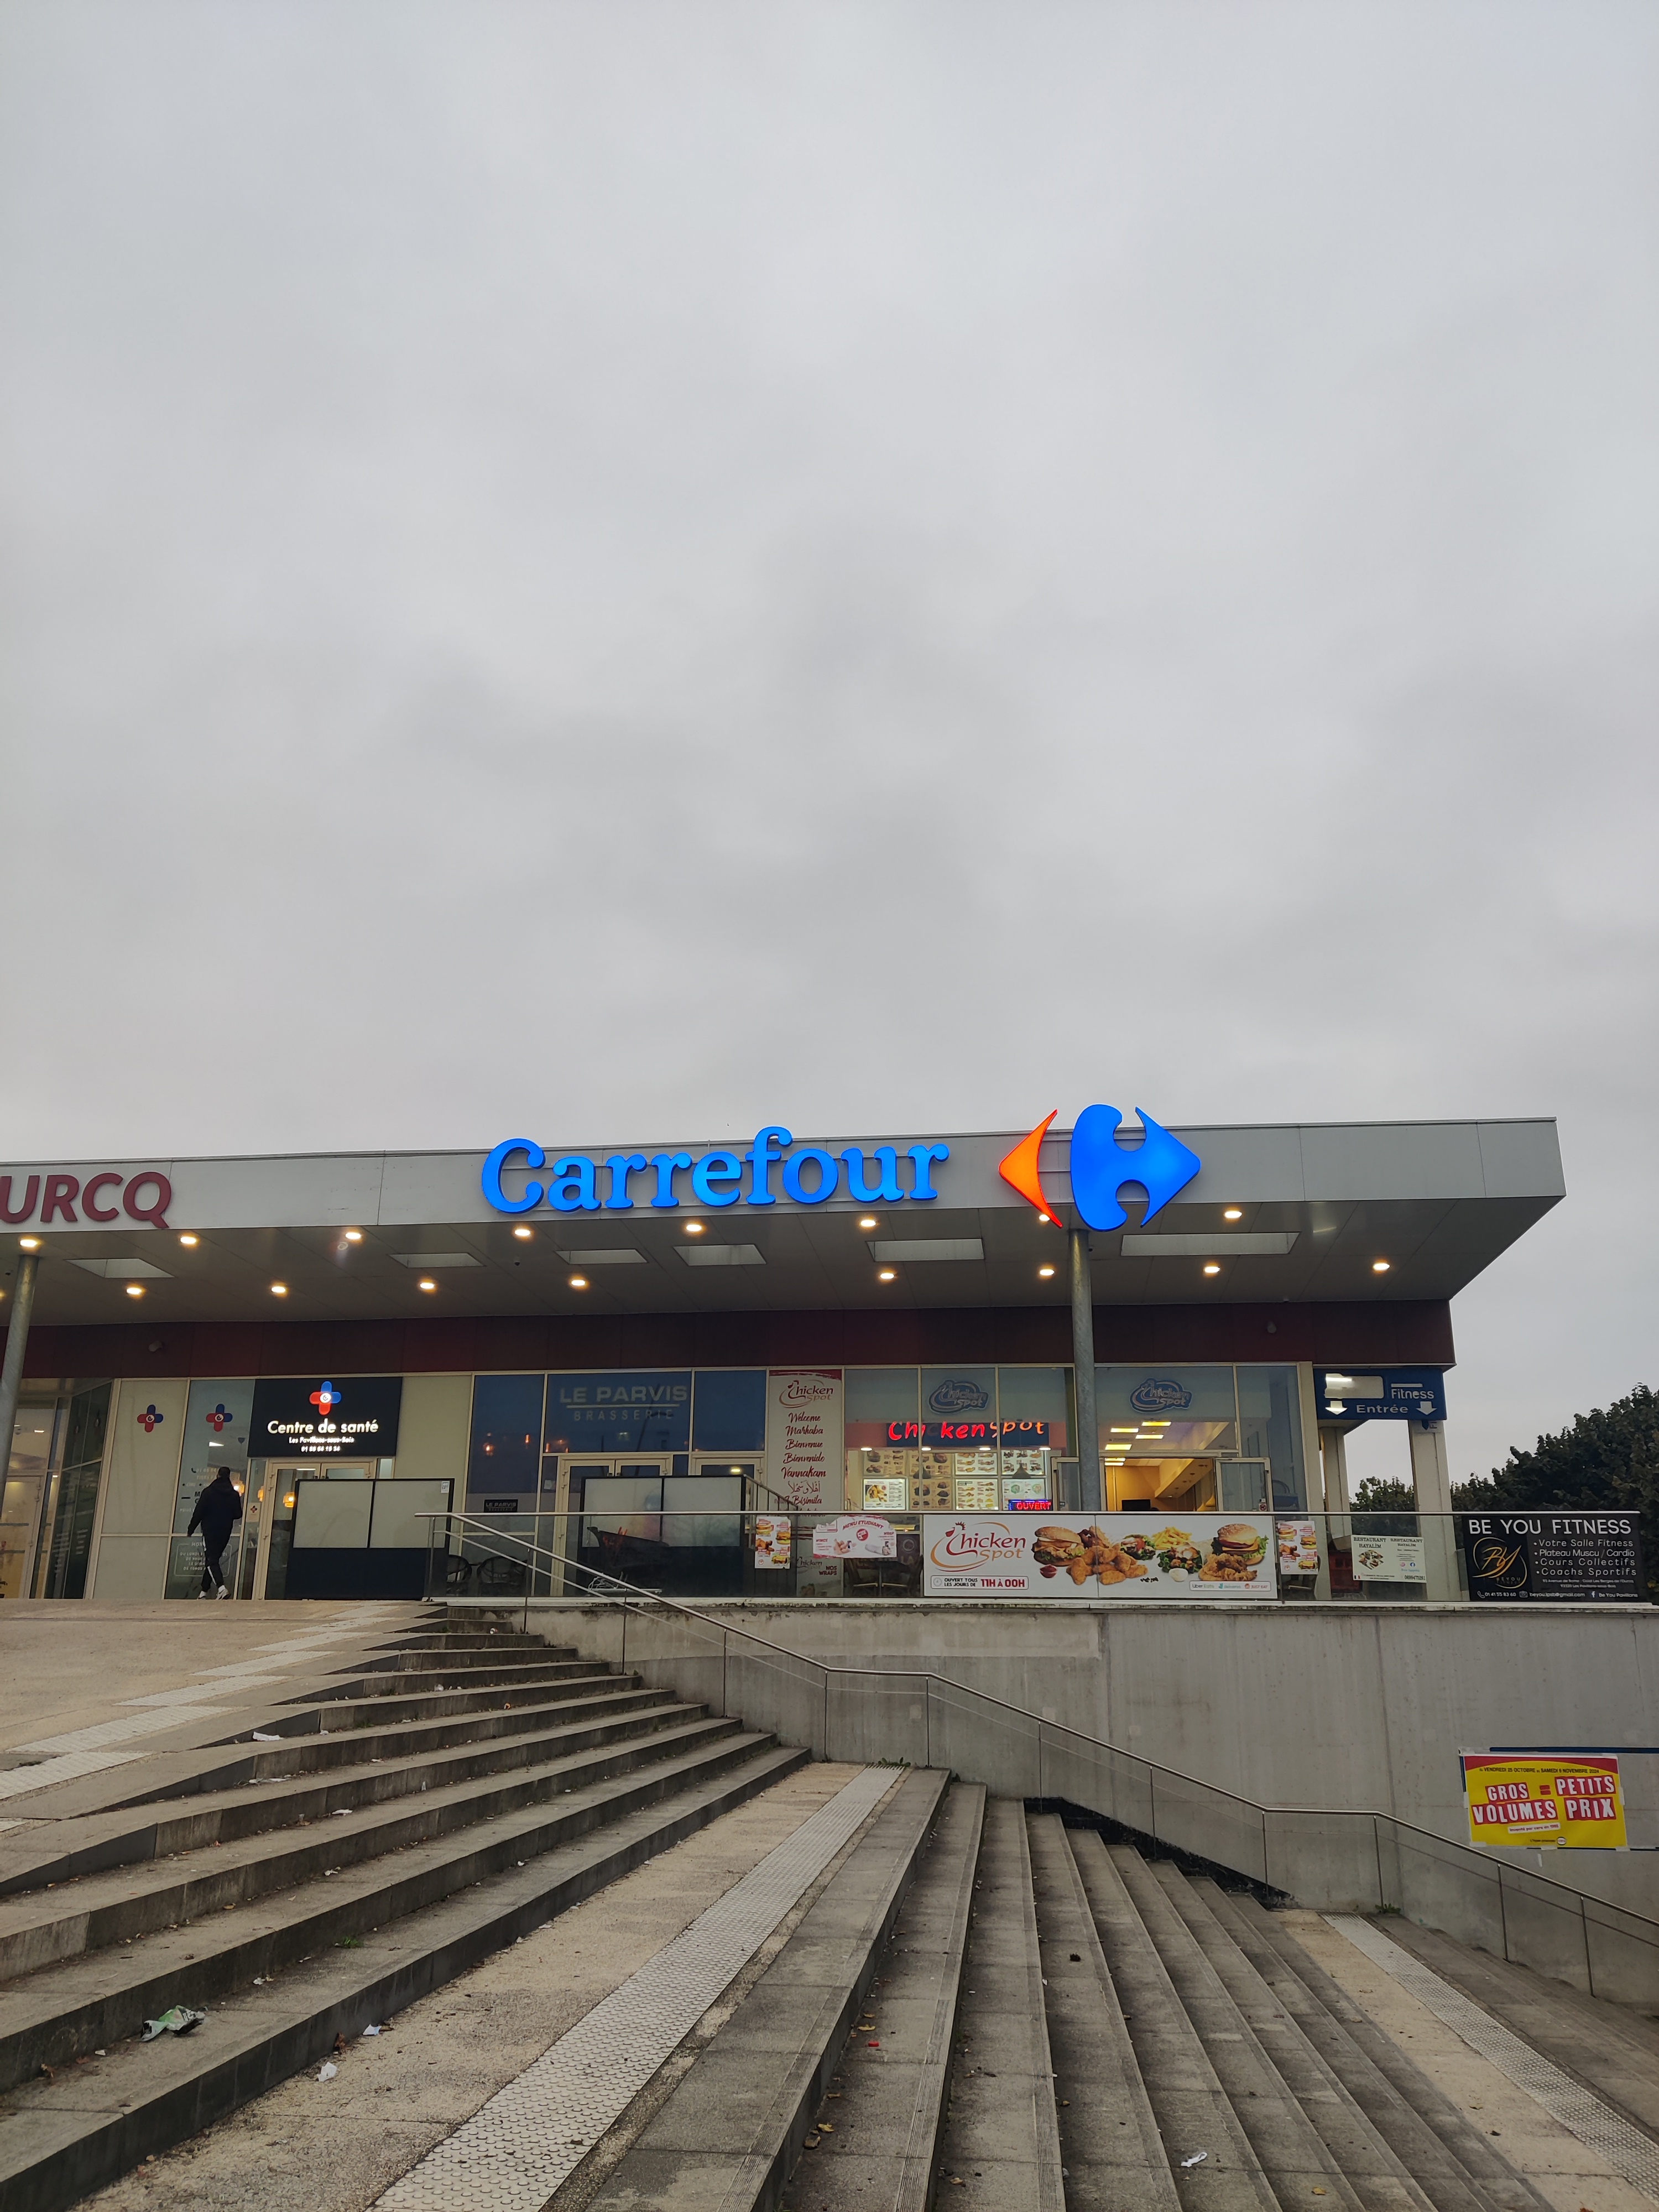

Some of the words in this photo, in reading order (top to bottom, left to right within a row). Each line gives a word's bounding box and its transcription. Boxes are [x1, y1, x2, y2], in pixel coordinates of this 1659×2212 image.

[481, 1126, 950, 1213] Carrefour
[0, 1171, 171, 1228] URCQ
[560, 1386, 587, 1403] LE
[596, 1385, 687, 1402] PARVIS
[787, 1380, 833, 1399] Chicken
[1391, 1389, 1434, 1399] Fitness
[1357, 1404, 1408, 1413] Entrée
[573, 1410, 674, 1421] BRASSERIE
[788, 1411, 821, 1423] Welcome
[267, 1420, 314, 1434] Centre
[317, 1418, 336, 1433] de
[340, 1419, 379, 1433] santé
[785, 1425, 823, 1436] Marhaba
[785, 1438, 823, 1450] Bienvenue
[782, 1451, 825, 1464] Bienvenido
[1016, 1501, 1051, 1510] OUVERT
[1469, 1519, 1492, 1534] BE
[1500, 1519, 1542, 1534] YOU
[1552, 1519, 1631, 1535] FITNESS
[946, 1532, 1026, 1558] Chicken
[979, 1548, 1024, 1562] spot
[1541, 1567, 1583, 1575] Coachs
[1588, 1567, 1637, 1577] Sportifs
[980, 1579, 995, 1587] 11H
[997, 1578, 1003, 1587] À
[1005, 1579, 1025, 1587] 00H
[1488, 1783, 1528, 1801] GROS
[1556, 1776, 1615, 1795] PETITS
[1472, 1800, 1557, 1824] VOLUMES
[1566, 1798, 1615, 1819] PRIX
